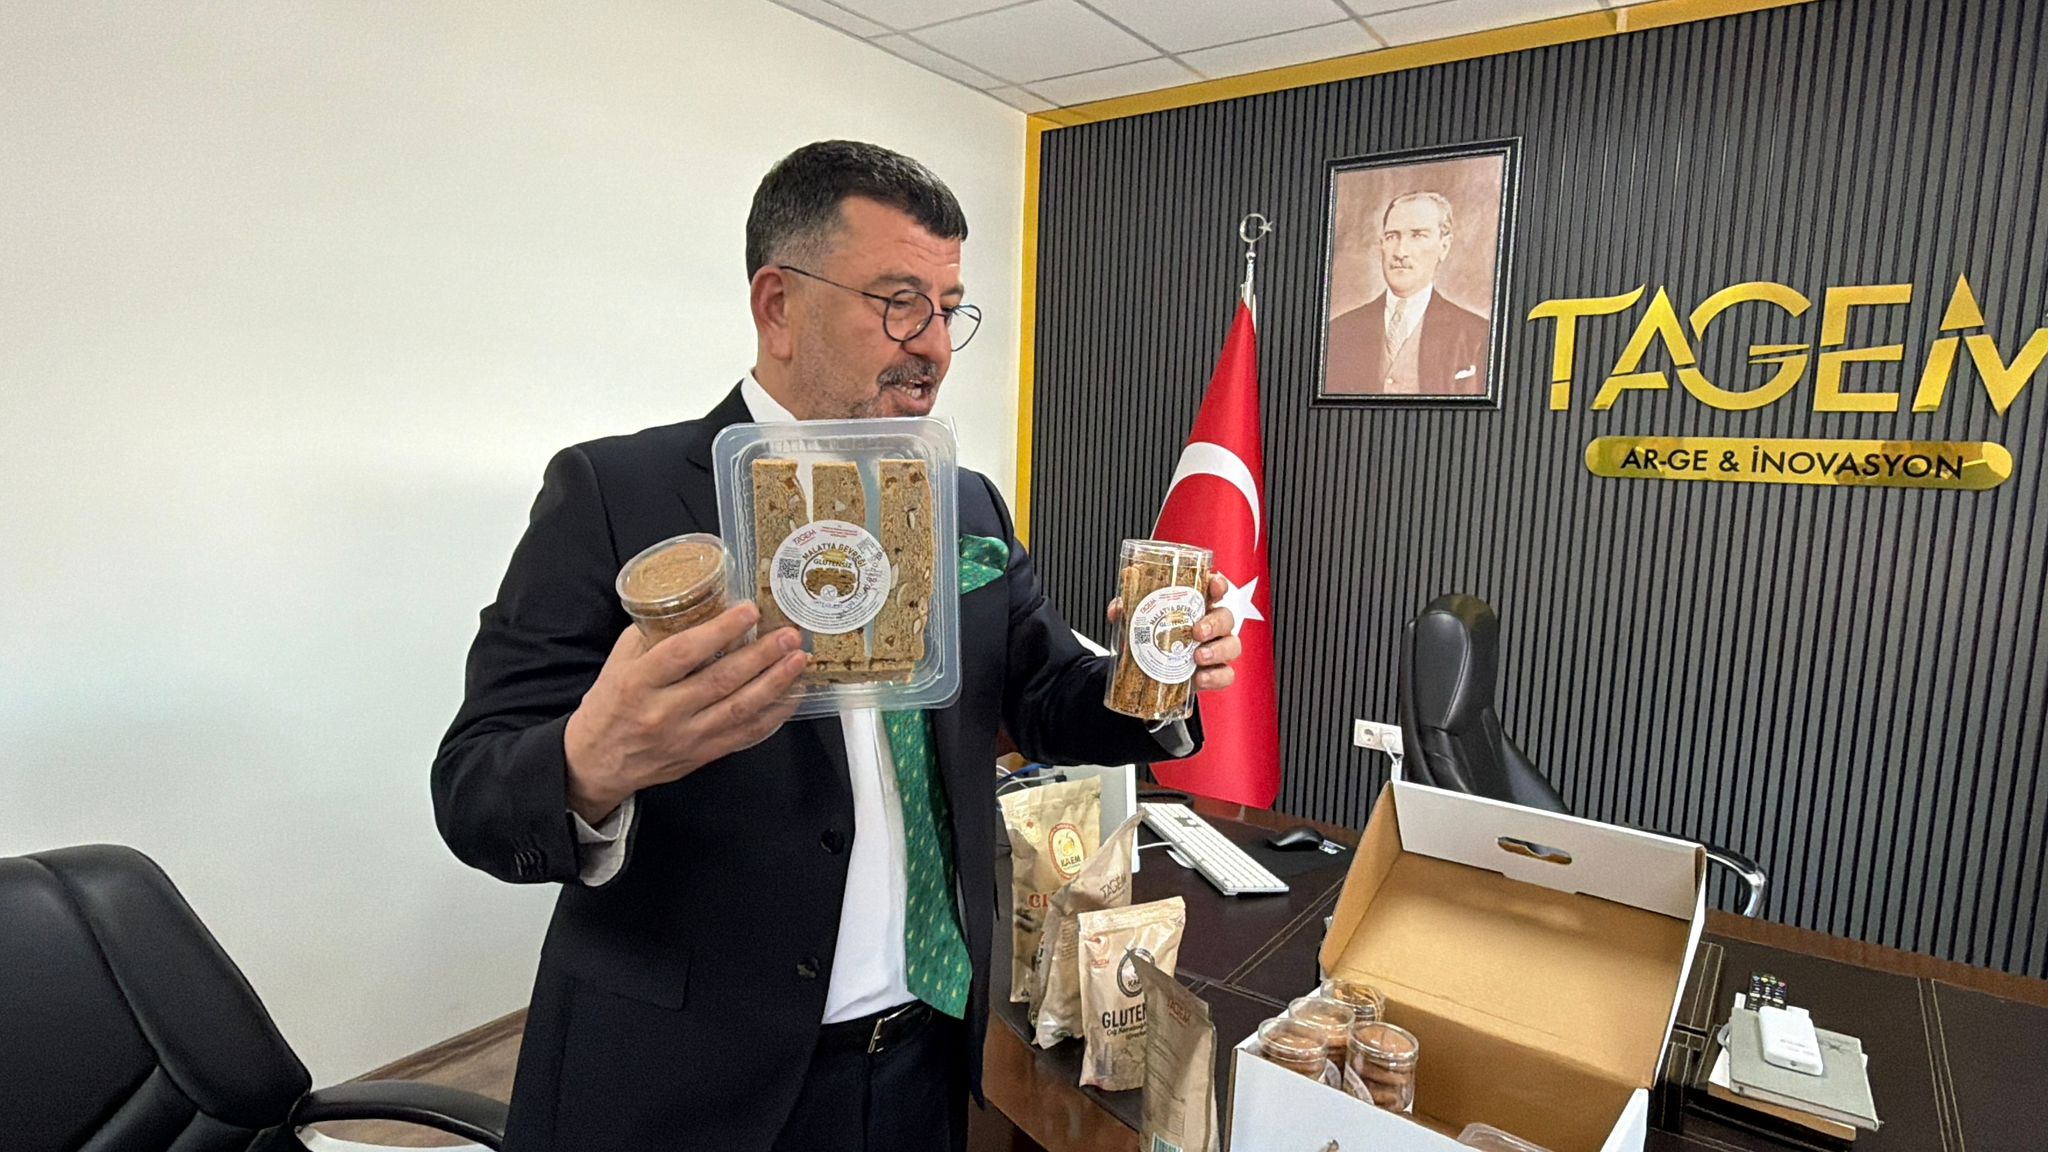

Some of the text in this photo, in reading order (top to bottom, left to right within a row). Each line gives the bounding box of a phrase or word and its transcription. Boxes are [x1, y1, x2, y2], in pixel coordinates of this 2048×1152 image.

[1527, 271, 2048, 416] TAGEM
[1621, 445, 1964, 481] AR-GE & İNOVASYON
[802, 542, 836, 561] MALATYA
[838, 543, 866, 567] GEVREĞİ
[813, 558, 852, 569] GLUTENSİZ
[1060, 855, 1081, 867] KAEM
